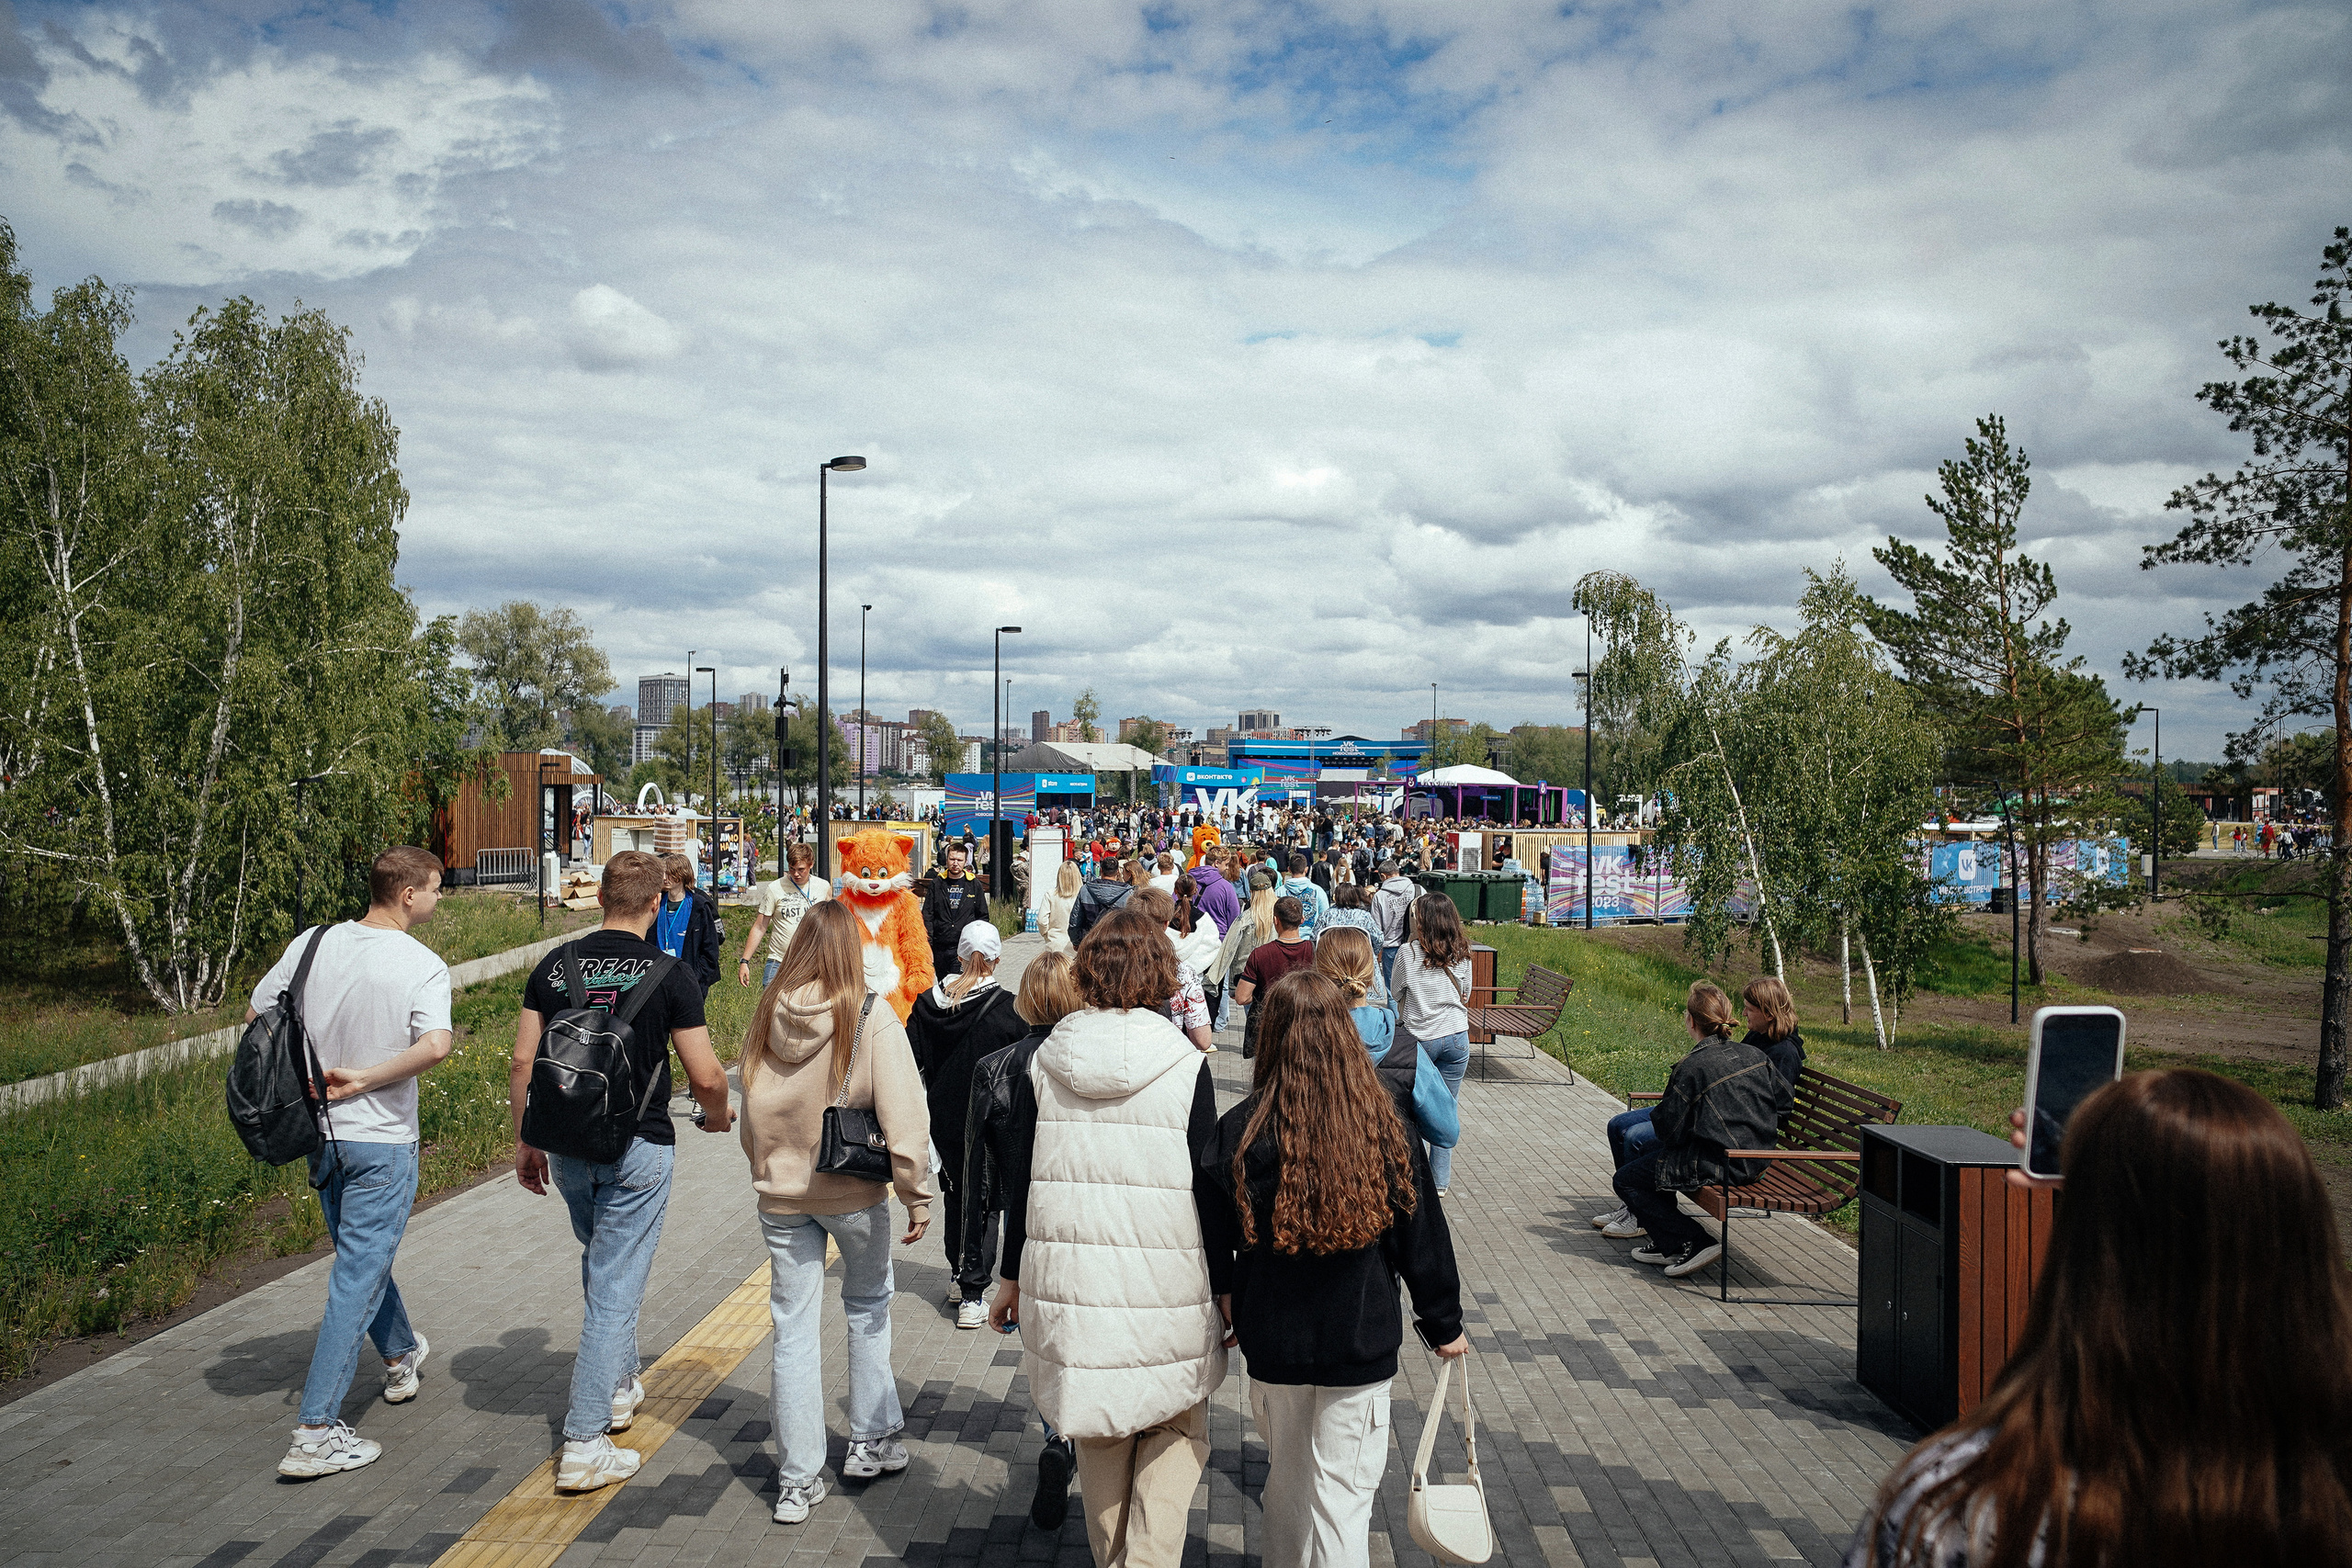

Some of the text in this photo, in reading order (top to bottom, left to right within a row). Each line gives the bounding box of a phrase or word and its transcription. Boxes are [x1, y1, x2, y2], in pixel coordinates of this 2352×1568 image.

[1280, 779, 1300, 788] fest
[1961, 859, 1973, 872] VK
[1578, 869, 1634, 895] fest
